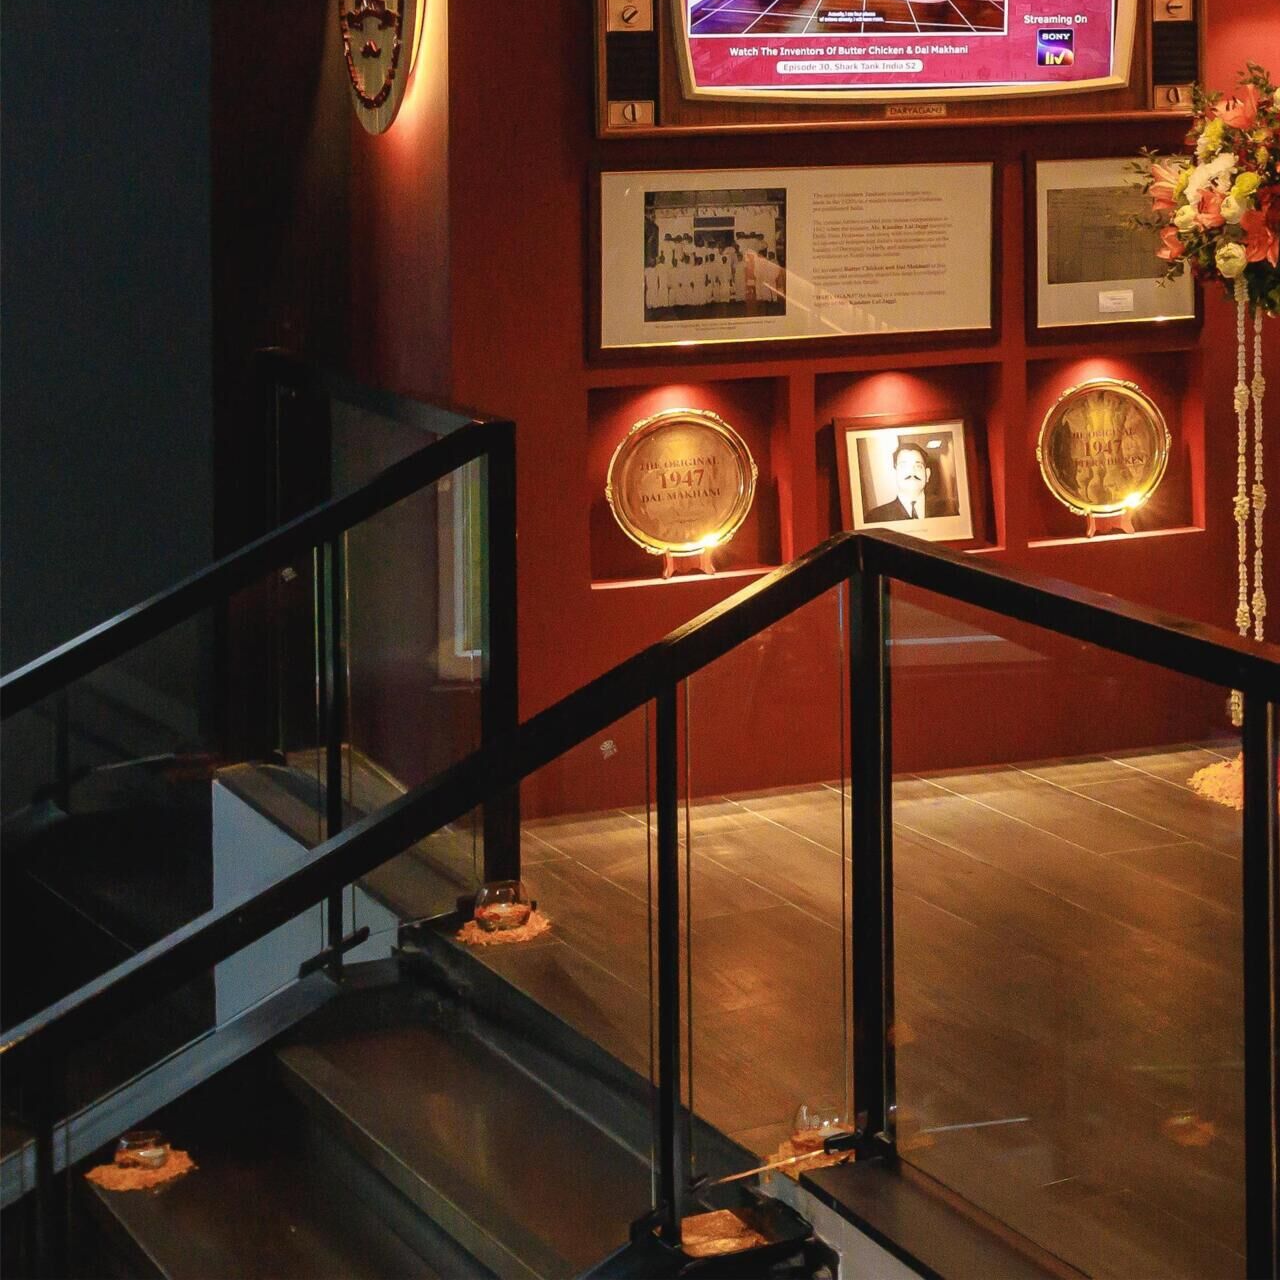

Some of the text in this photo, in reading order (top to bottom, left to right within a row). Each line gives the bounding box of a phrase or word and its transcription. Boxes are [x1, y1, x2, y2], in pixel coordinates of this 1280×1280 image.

[1023, 14, 1088, 26] Streaming On
[1041, 32, 1071, 40] SONY
[729, 45, 969, 56] Watch The Inventors Of Butter Chicken & Dal Makhani
[783, 63, 817, 73] Episode
[834, 62, 858, 71] Shark
[861, 62, 879, 70] Tank
[882, 62, 904, 70] India
[890, 106, 945, 115] DARYAGANJ
[1084, 439, 1122, 458] 1947
[640, 455, 720, 471] THE ORIGINAL
[659, 469, 704, 489] 1947
[641, 487, 720, 504] DAL MAKHANI
